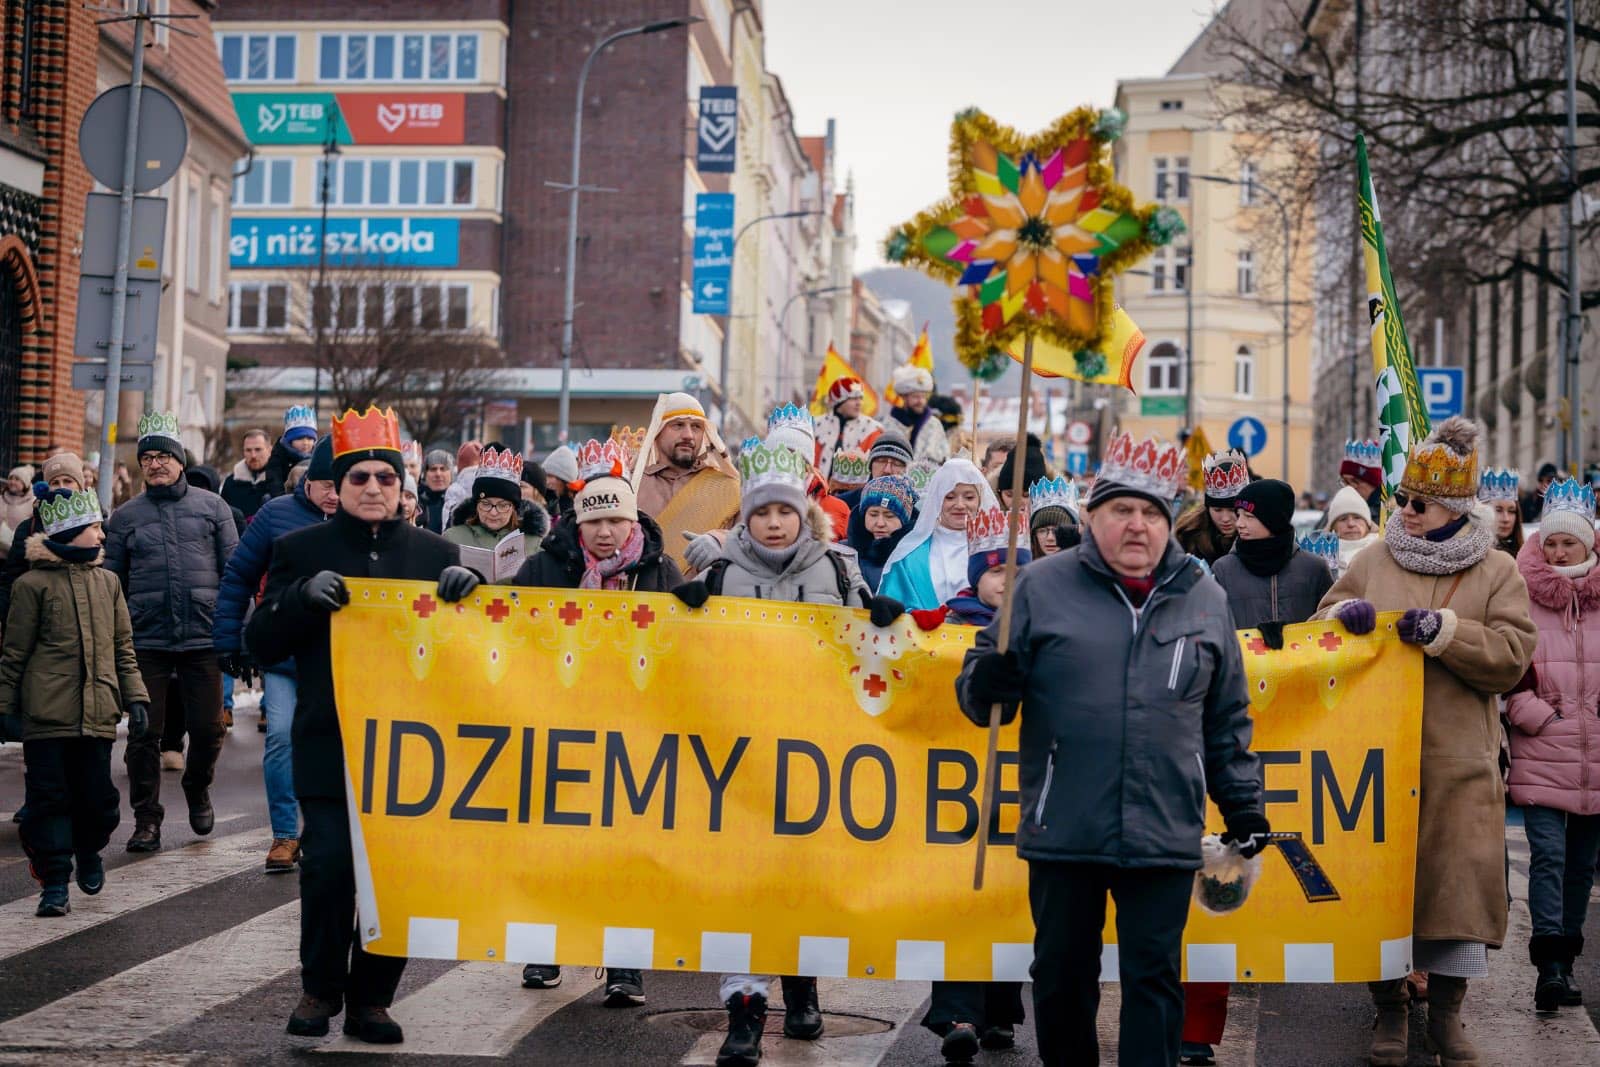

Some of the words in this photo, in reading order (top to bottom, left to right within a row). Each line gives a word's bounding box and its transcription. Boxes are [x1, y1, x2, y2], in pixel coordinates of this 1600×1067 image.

[288, 103, 323, 119] TEB
[408, 103, 443, 119] TEB
[701, 98, 736, 114] TEB
[266, 225, 316, 256] niż
[324, 218, 435, 253] szkoła
[1423, 373, 1453, 415] P
[582, 493, 620, 509] ROMA
[361, 718, 752, 833] IDZIEMY
[773, 737, 898, 842] DO
